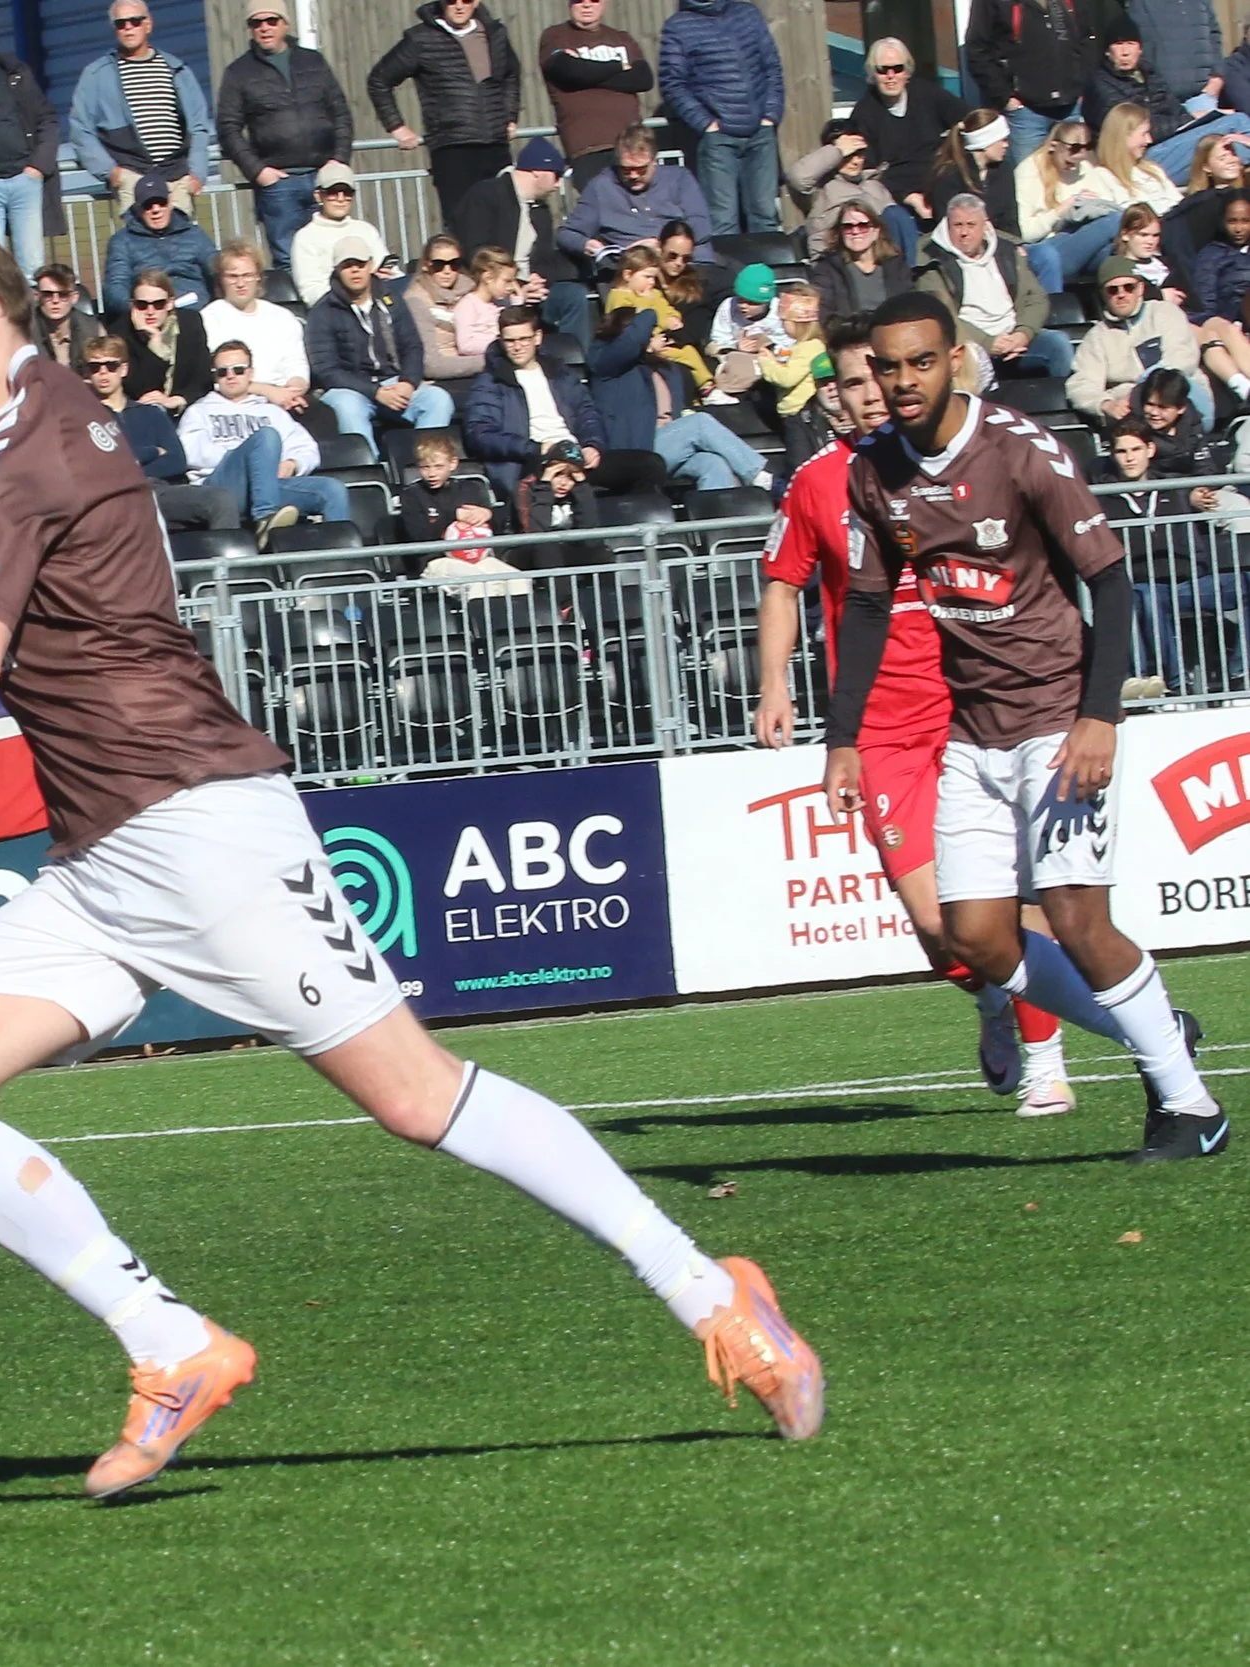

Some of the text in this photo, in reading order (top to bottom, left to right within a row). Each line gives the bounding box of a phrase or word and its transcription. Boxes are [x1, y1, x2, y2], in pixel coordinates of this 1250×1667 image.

[876, 793, 891, 817] 9
[443, 814, 627, 898] ABC
[445, 895, 630, 942] ELEKTRO
[790, 915, 868, 947] Hotel
[298, 971, 322, 1006] 6
[454, 965, 613, 992] www.abcelektro.no
